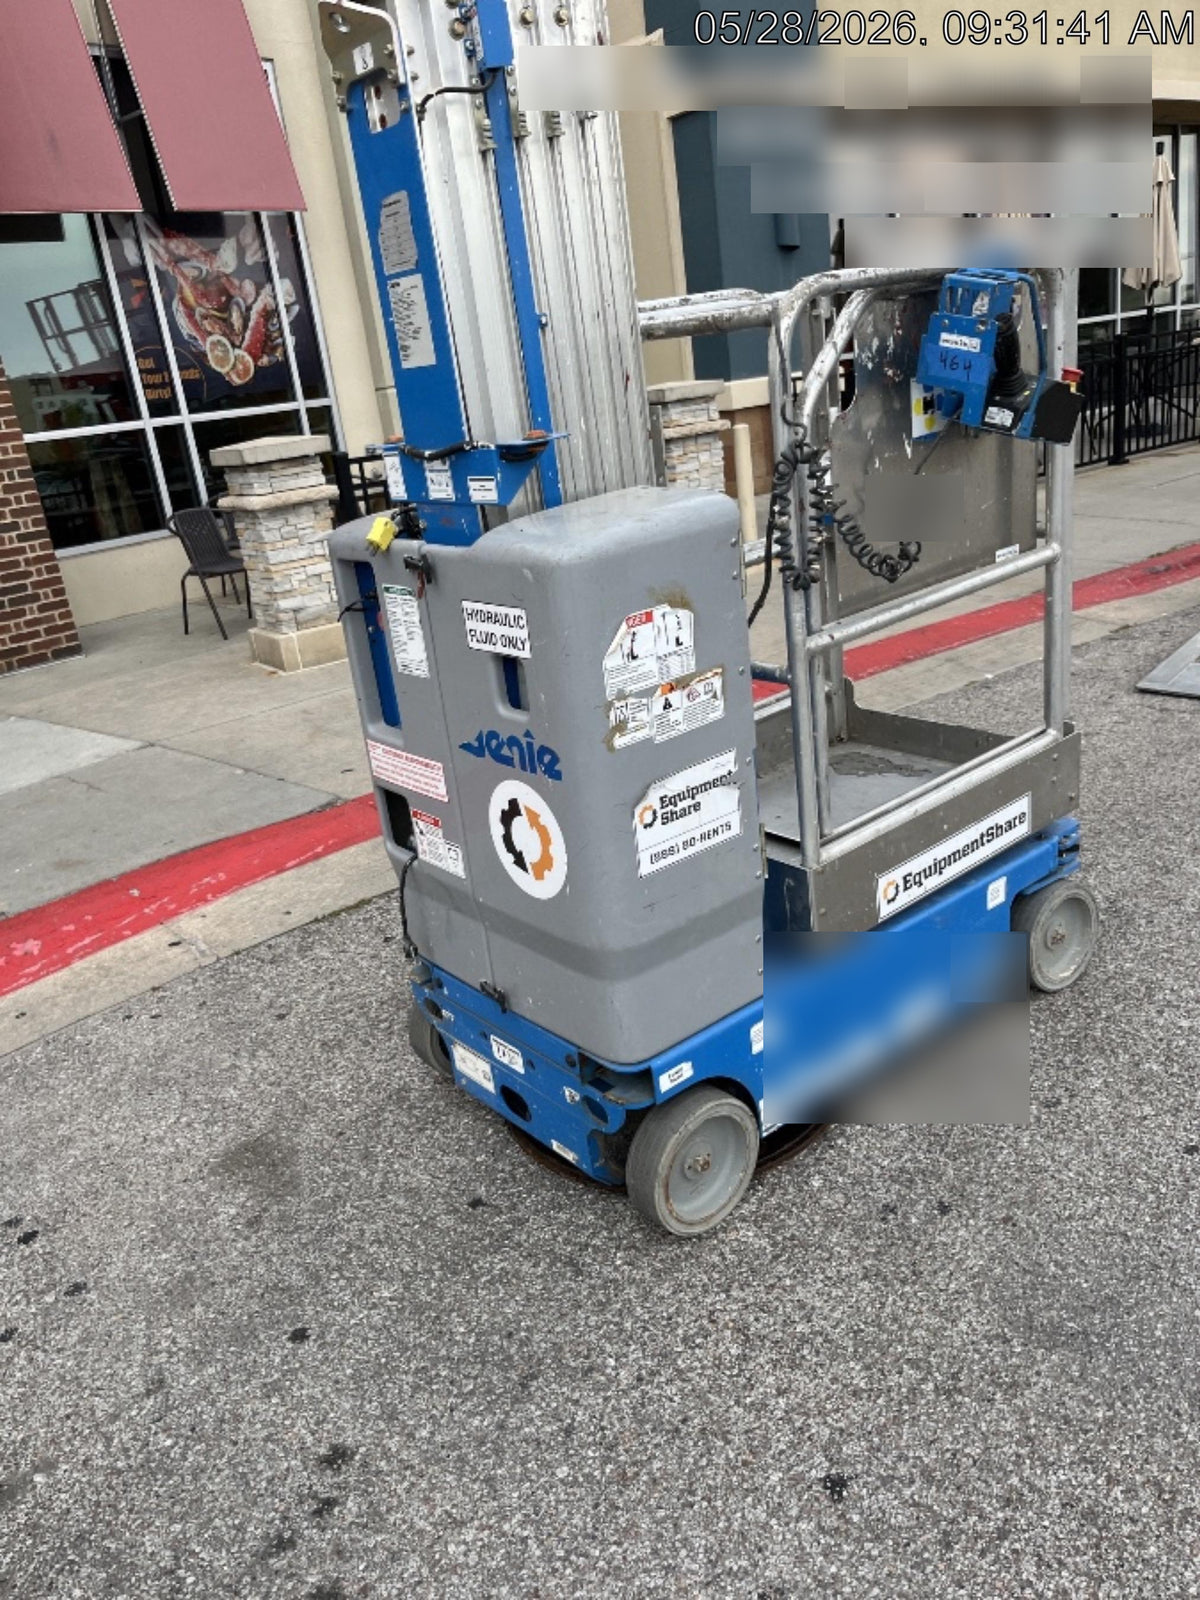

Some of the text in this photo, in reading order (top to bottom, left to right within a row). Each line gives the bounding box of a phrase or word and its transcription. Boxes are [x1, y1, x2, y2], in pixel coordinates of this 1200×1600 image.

[939, 350, 973, 382] 464
[464, 607, 526, 630] HYDRAULIC
[468, 628, 527, 652] FLUID ONLY
[660, 801, 702, 826] Share
[901, 811, 1028, 893] EquipmentShare
